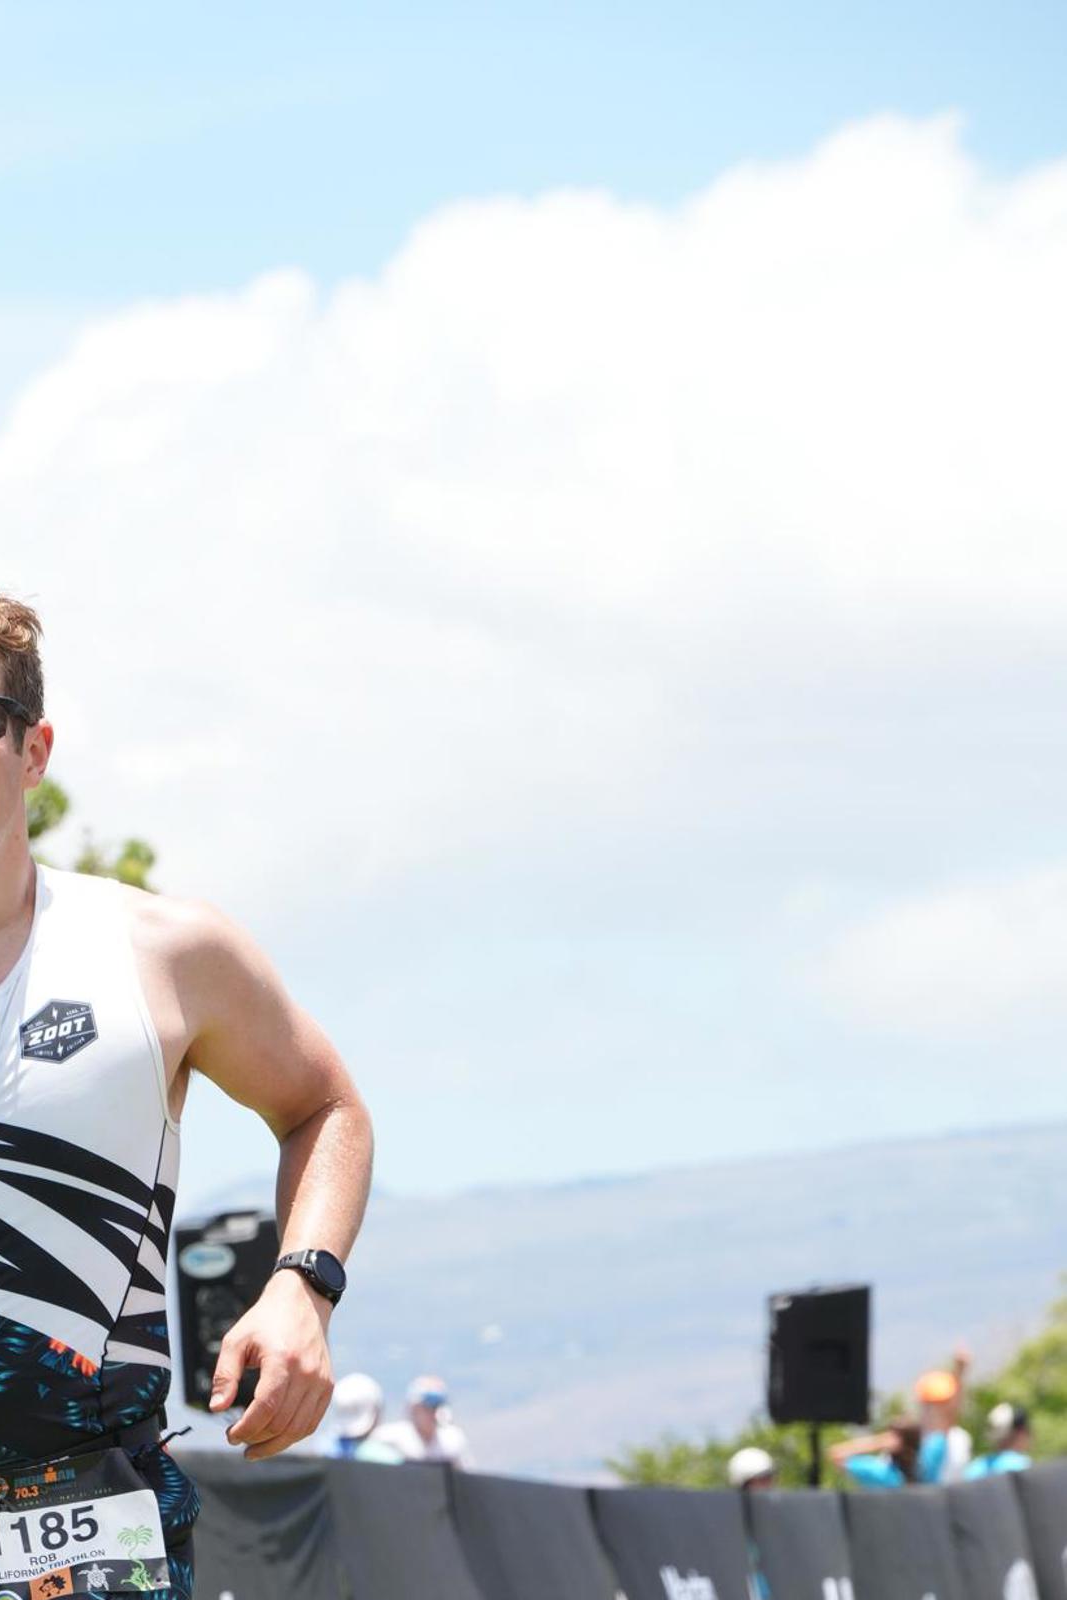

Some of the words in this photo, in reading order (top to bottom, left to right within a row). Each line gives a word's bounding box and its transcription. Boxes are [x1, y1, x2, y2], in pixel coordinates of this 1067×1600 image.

[28, 1017, 86, 1046] ZOOT
[14, 1486, 40, 1499] 70.3
[29, 1552, 58, 1566] ROB
[49, 1548, 107, 1570] TRIATHLON
